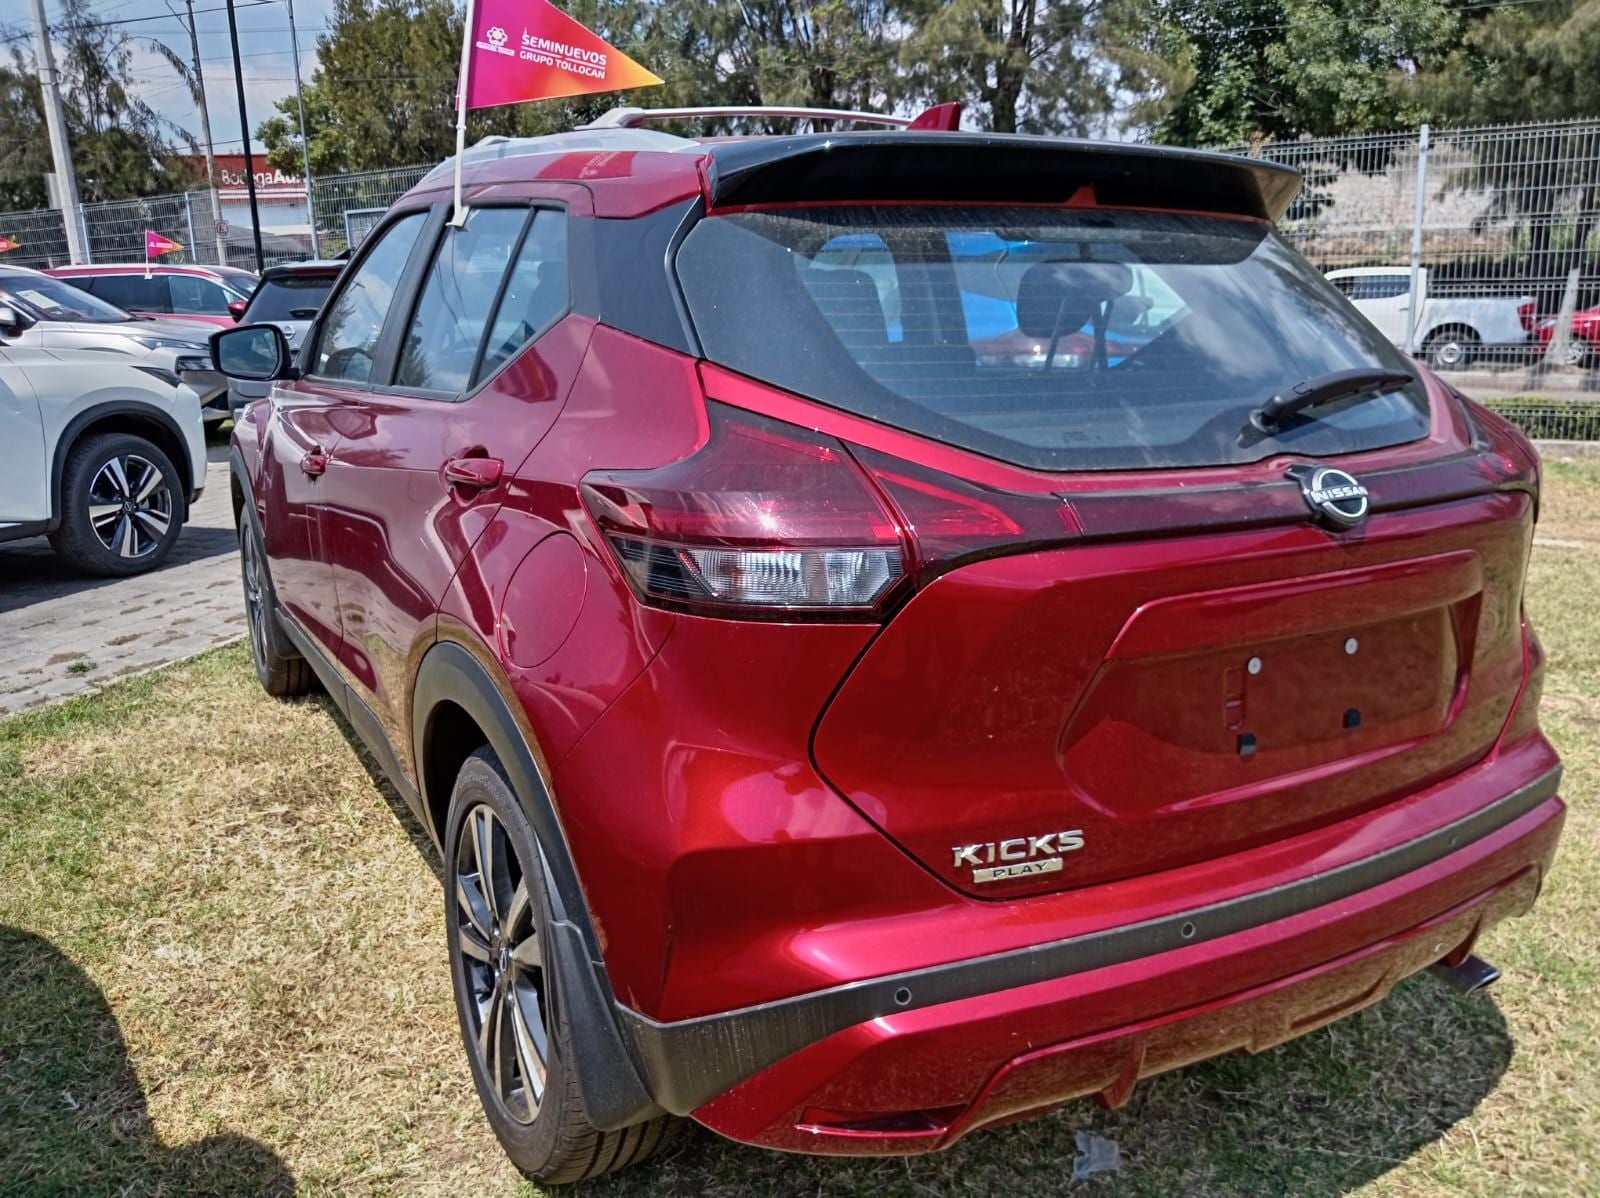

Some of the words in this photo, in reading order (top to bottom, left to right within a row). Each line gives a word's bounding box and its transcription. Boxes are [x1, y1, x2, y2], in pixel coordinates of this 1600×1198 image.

[521, 34, 607, 65] SEMINUEVOS
[520, 50, 554, 66] GRUPO
[555, 59, 605, 79] TOLLOCAN
[1312, 486, 1368, 503] NISSAN
[952, 830, 1085, 867] KICKS
[992, 862, 1048, 878] PLAY
